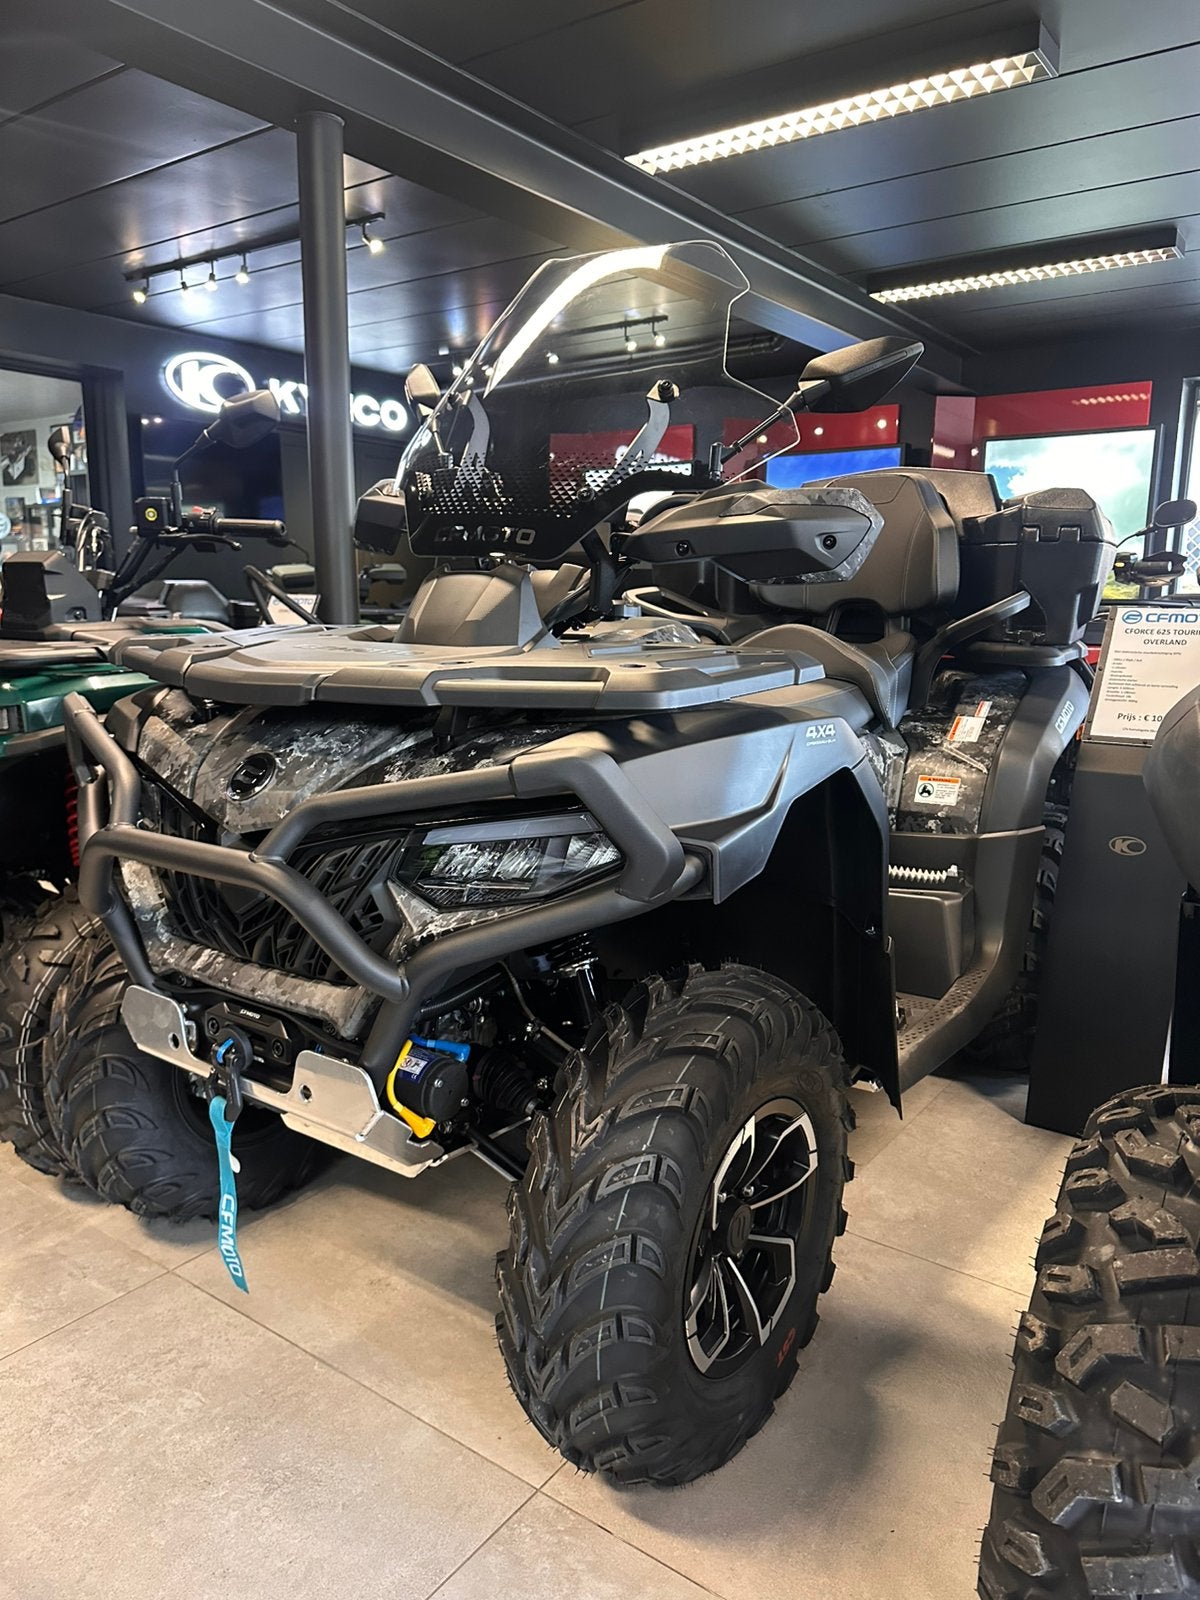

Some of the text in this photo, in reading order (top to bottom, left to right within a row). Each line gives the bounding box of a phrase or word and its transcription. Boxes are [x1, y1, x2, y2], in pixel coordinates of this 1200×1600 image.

[1145, 613, 1200, 623] CFMO
[1124, 627, 1154, 635] CFORCE
[1143, 638, 1187, 646] OVERLAND
[1117, 712, 1136, 722] Prijs
[221, 1193, 243, 1278] CFMOTO
